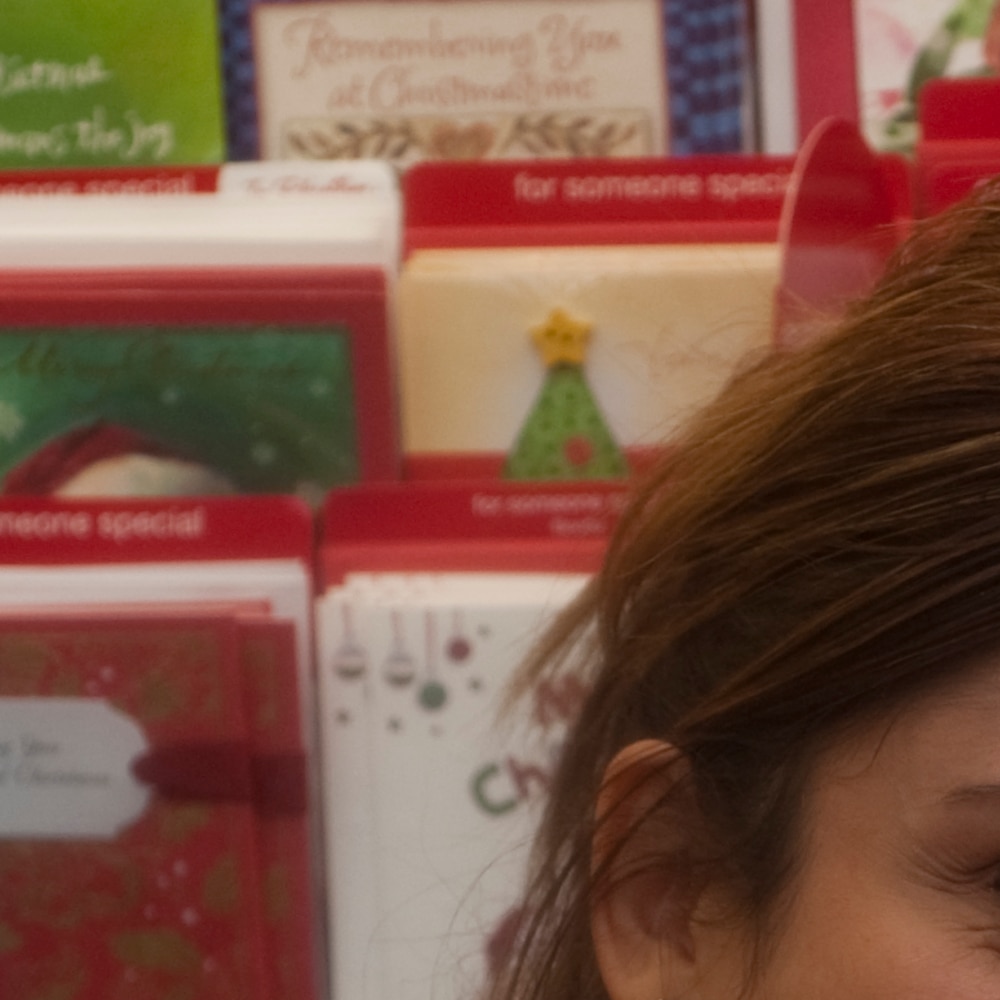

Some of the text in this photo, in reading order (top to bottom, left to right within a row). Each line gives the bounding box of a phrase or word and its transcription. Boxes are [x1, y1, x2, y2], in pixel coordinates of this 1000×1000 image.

[513, 171, 554, 201] for
[562, 175, 701, 201] someone
[97, 504, 206, 546] special
